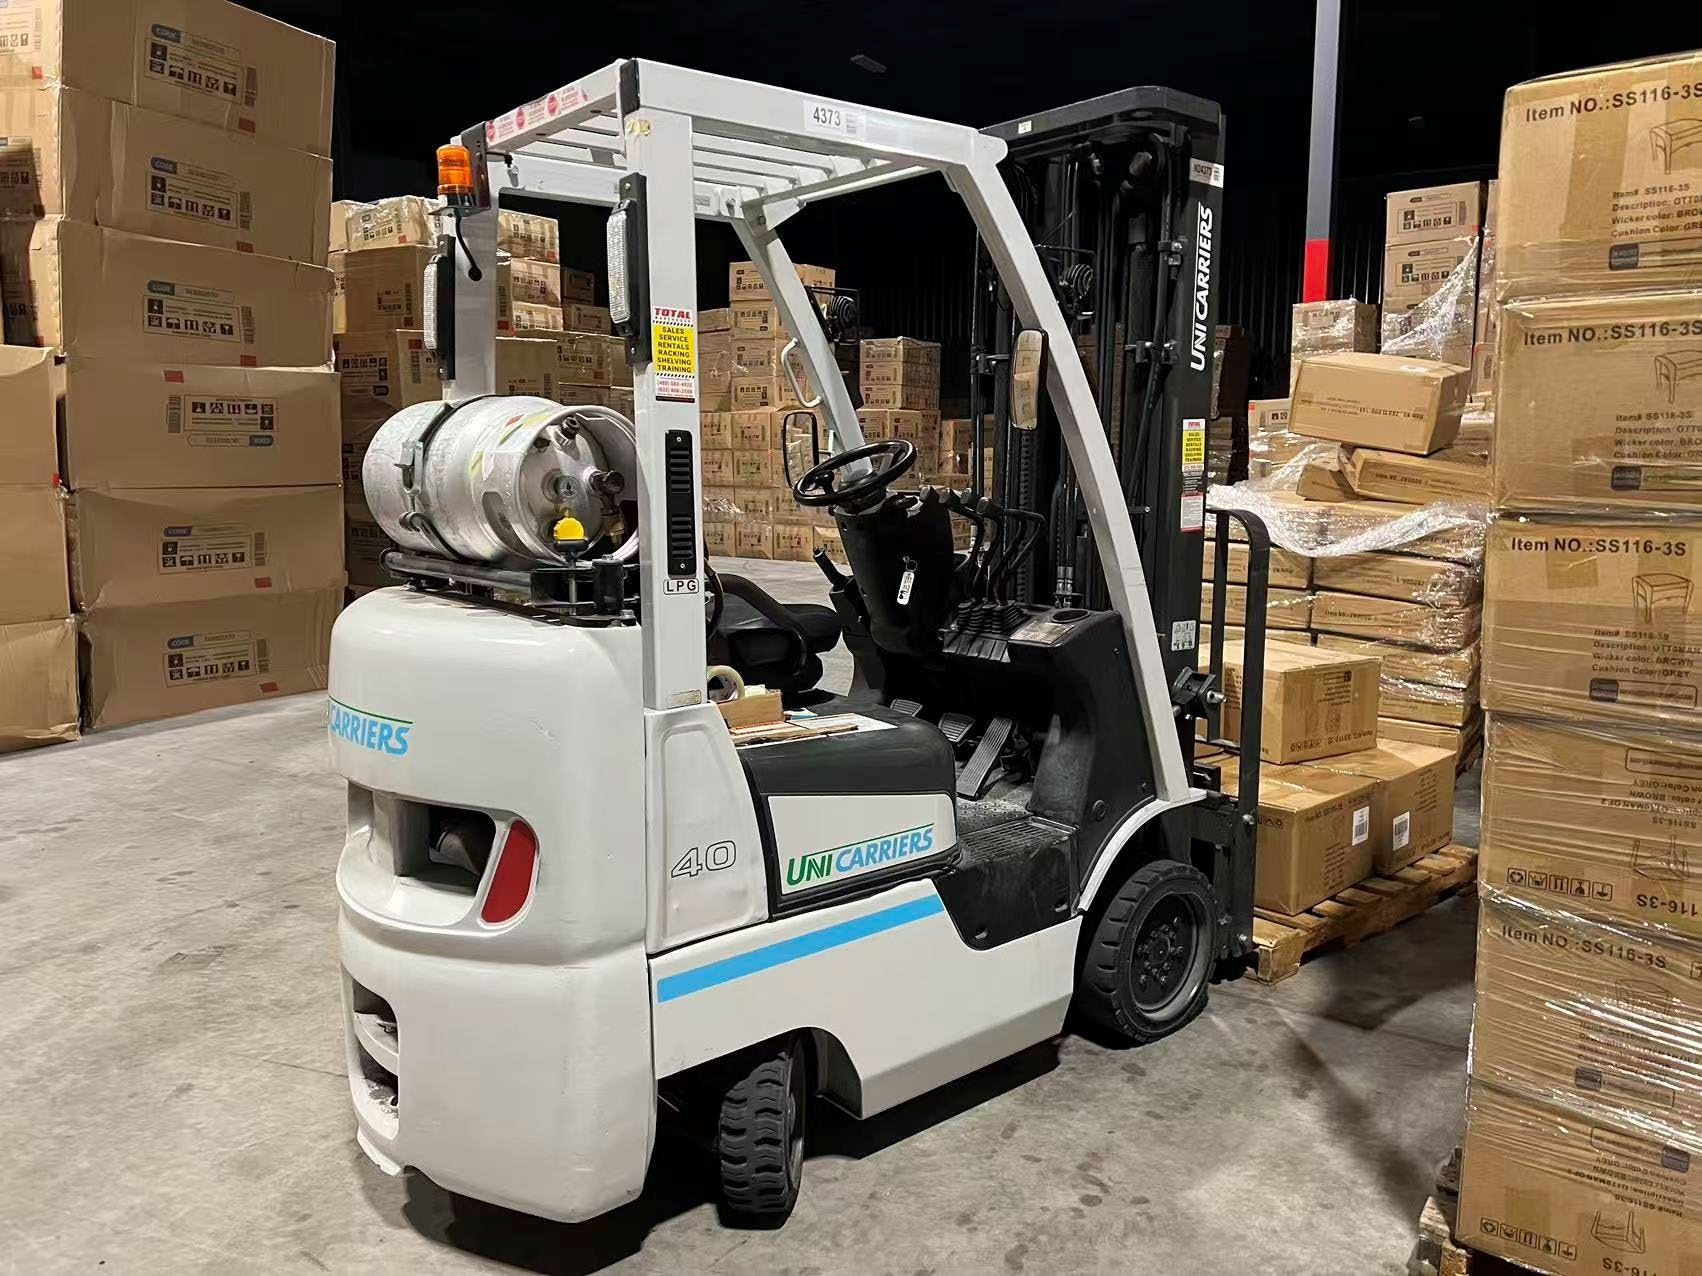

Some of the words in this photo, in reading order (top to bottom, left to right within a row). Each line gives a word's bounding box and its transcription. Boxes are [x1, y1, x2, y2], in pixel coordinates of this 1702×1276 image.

[813, 106, 841, 126] 4373
[1526, 105, 1564, 122] Item
[1611, 215, 1644, 225] Wicker
[1611, 227, 1651, 238] Cushion
[1191, 202, 1212, 370] UNICARRIERS
[654, 308, 691, 319] TOTAL
[662, 327, 685, 335] SALES
[659, 334, 689, 343] SERVICE
[1524, 332, 1562, 346] Item
[658, 342, 690, 350] RENTALS
[658, 350, 690, 358] RACKING
[657, 357, 692, 366] SHELVING
[658, 365, 692, 374] TRAINING
[1511, 537, 1549, 552] Item
[665, 579, 699, 592] LPG
[1592, 664, 1630, 673] Cushion
[1632, 779, 1660, 789] GREY
[1629, 790, 1666, 801] BROWN
[670, 840, 737, 879] 40
[1503, 925, 1539, 943] Item
